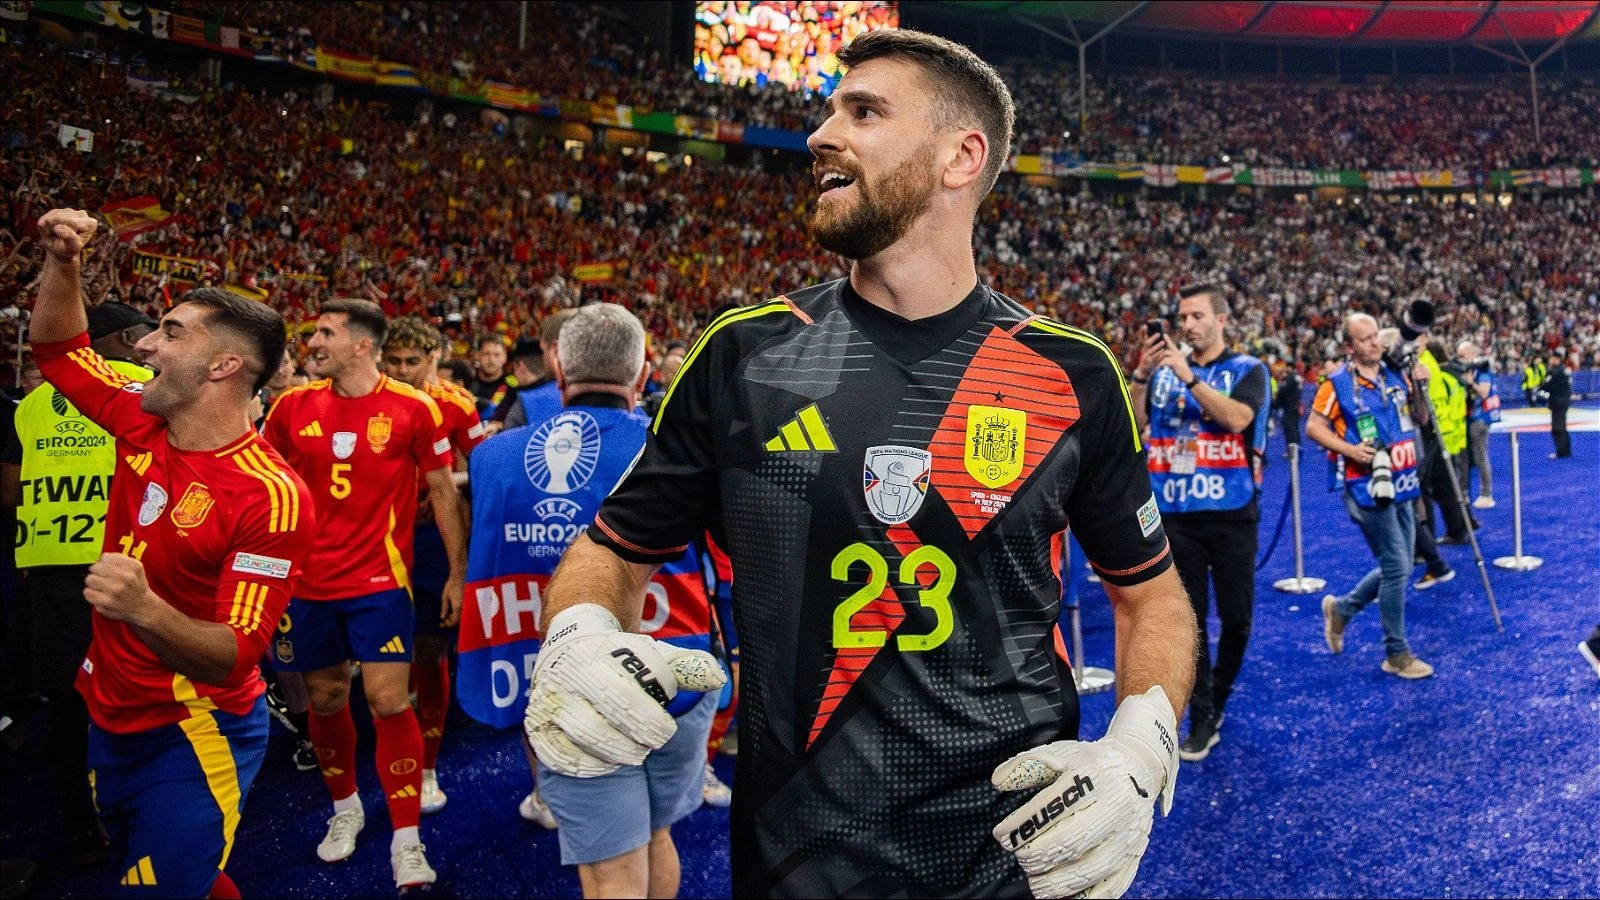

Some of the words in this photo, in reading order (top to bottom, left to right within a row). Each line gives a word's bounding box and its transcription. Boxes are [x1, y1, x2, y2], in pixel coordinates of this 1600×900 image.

[55, 422, 86, 433] UEFA
[908, 450, 929, 459] LEAGUE
[1197, 439, 1246, 460] TECH
[20, 475, 113, 507] TEWA
[330, 463, 352, 500] 5
[1163, 473, 1226, 503] 01-08
[536, 504, 578, 519] UEFA
[876, 511, 897, 522] WINNER
[831, 542, 957, 652] 23
[1010, 774, 1095, 848] reusch
